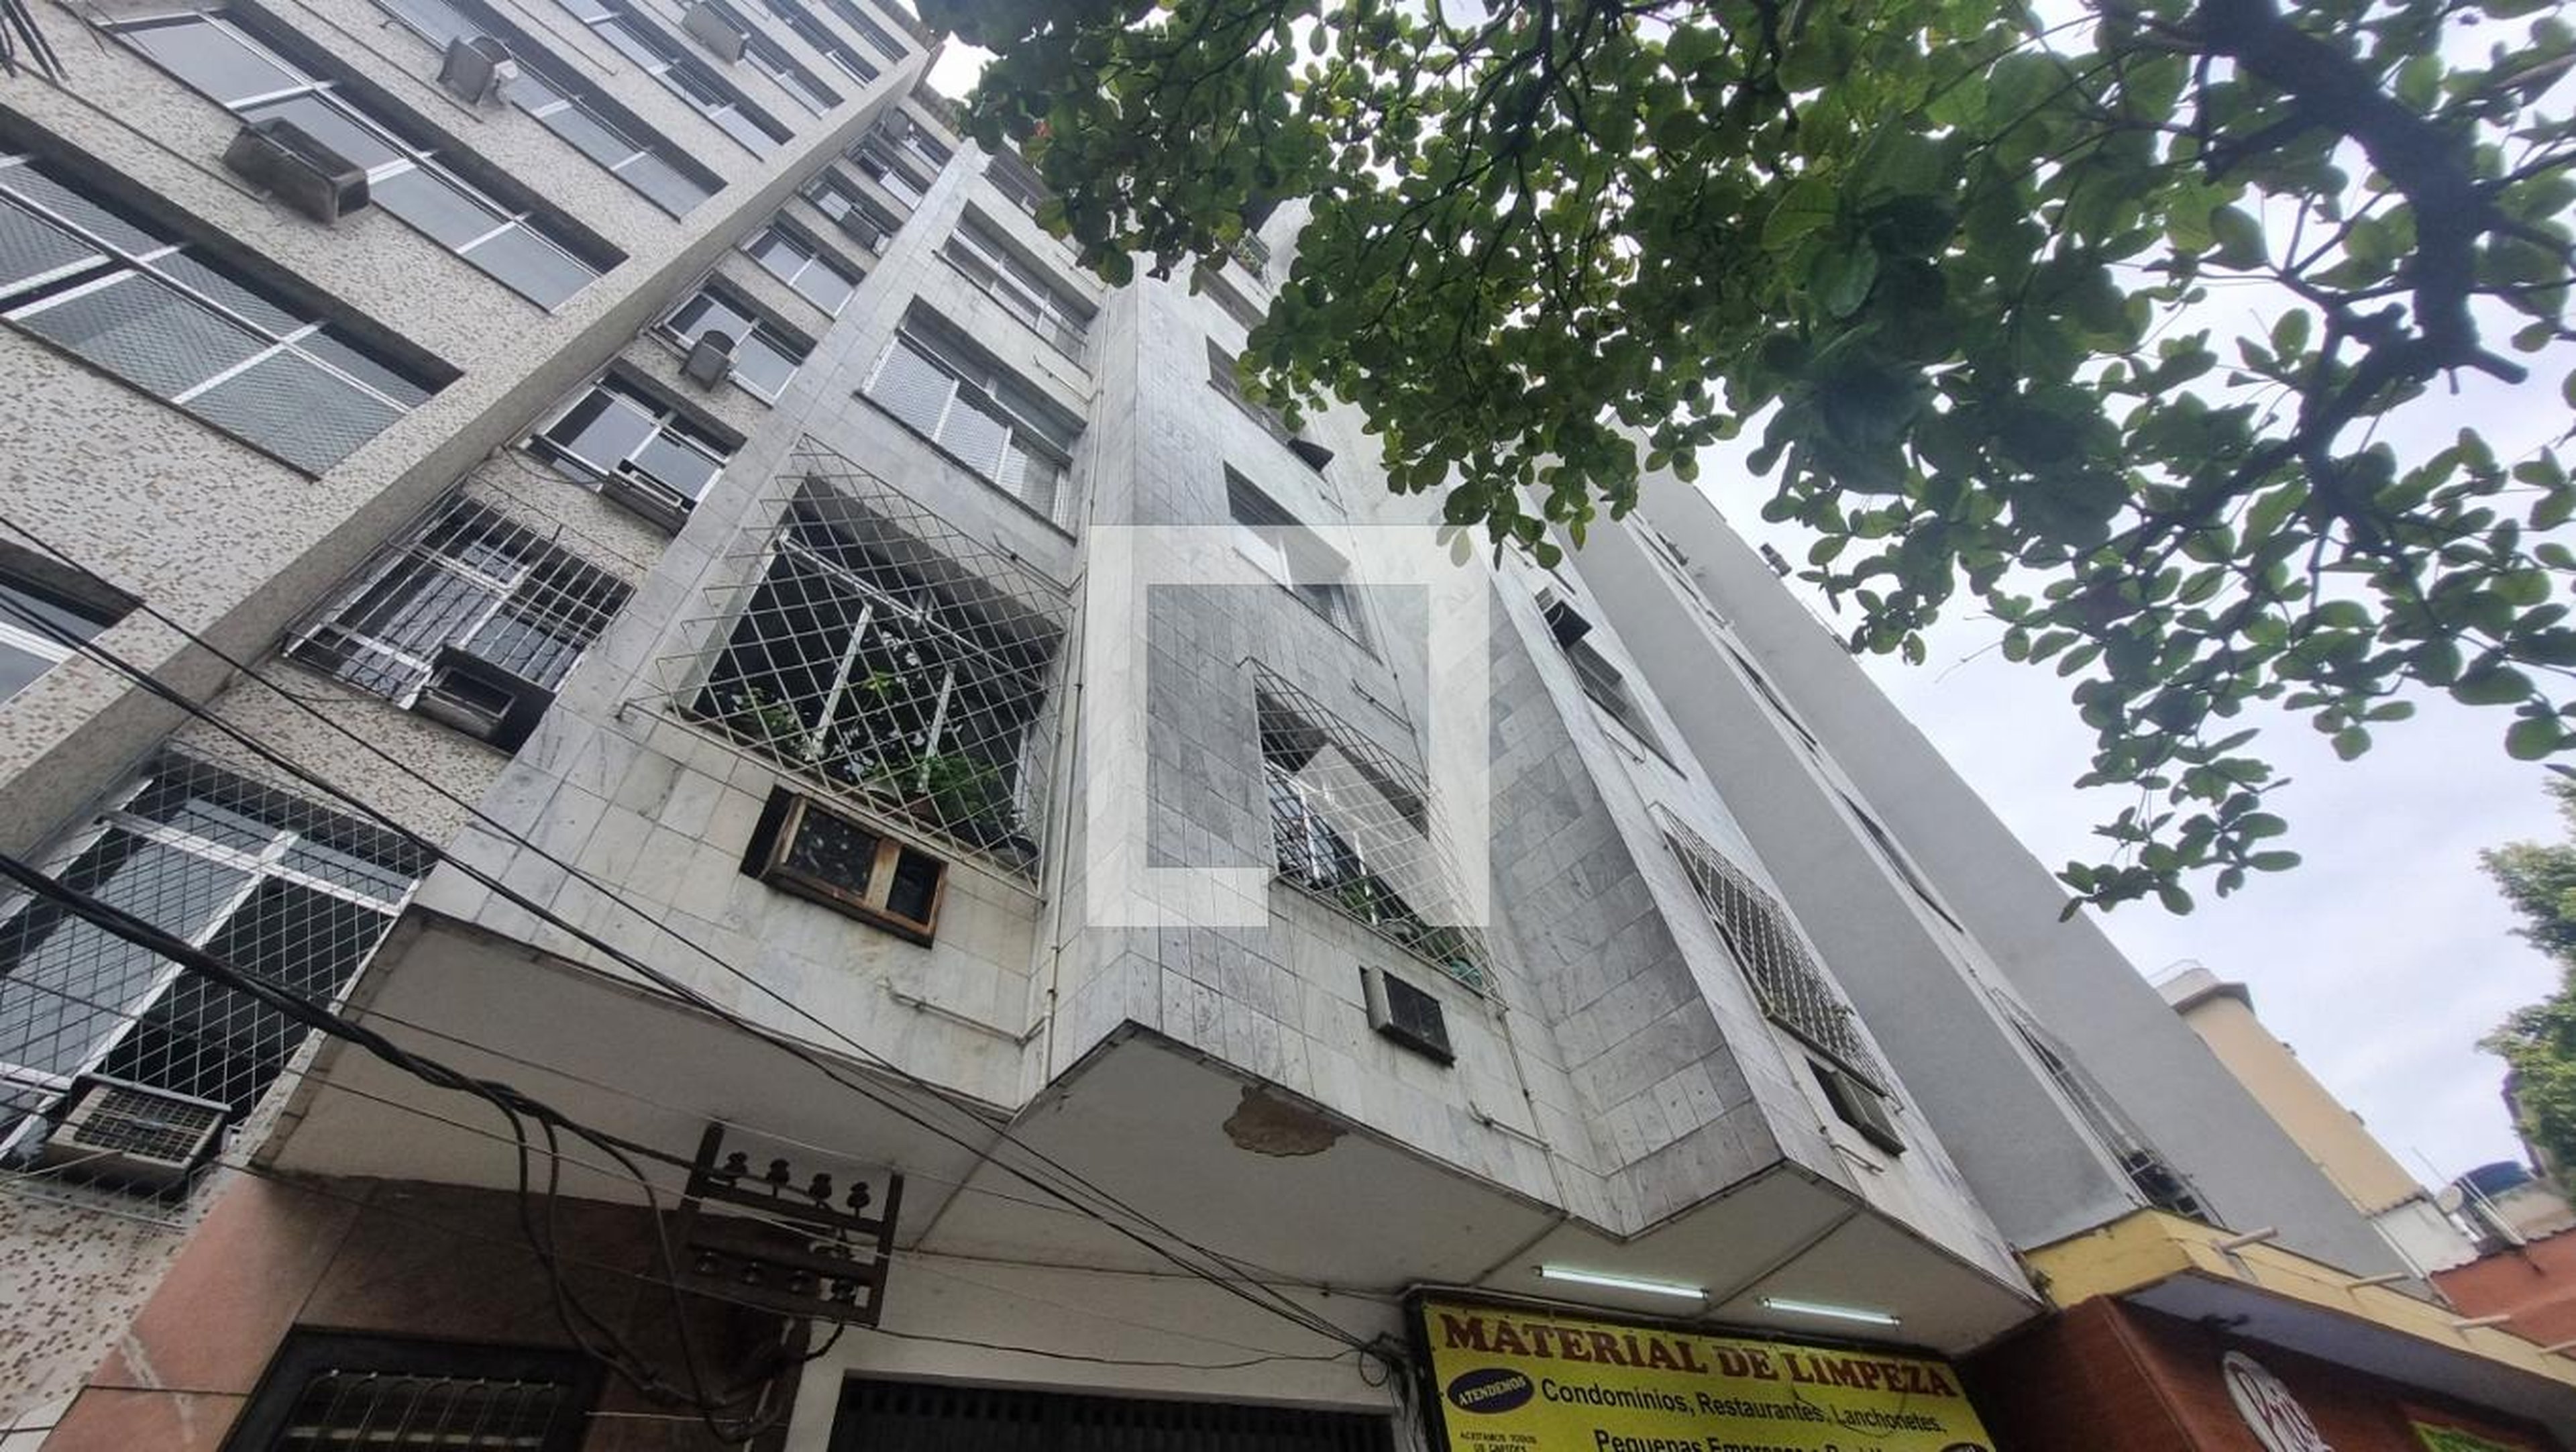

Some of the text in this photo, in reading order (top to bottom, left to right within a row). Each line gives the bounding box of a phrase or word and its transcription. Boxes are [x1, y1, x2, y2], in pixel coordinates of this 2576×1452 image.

[1439, 1314, 1959, 1396] MATERIAL DE LIMPEZA
[1458, 1376, 1527, 1406] ATENDEMOS
